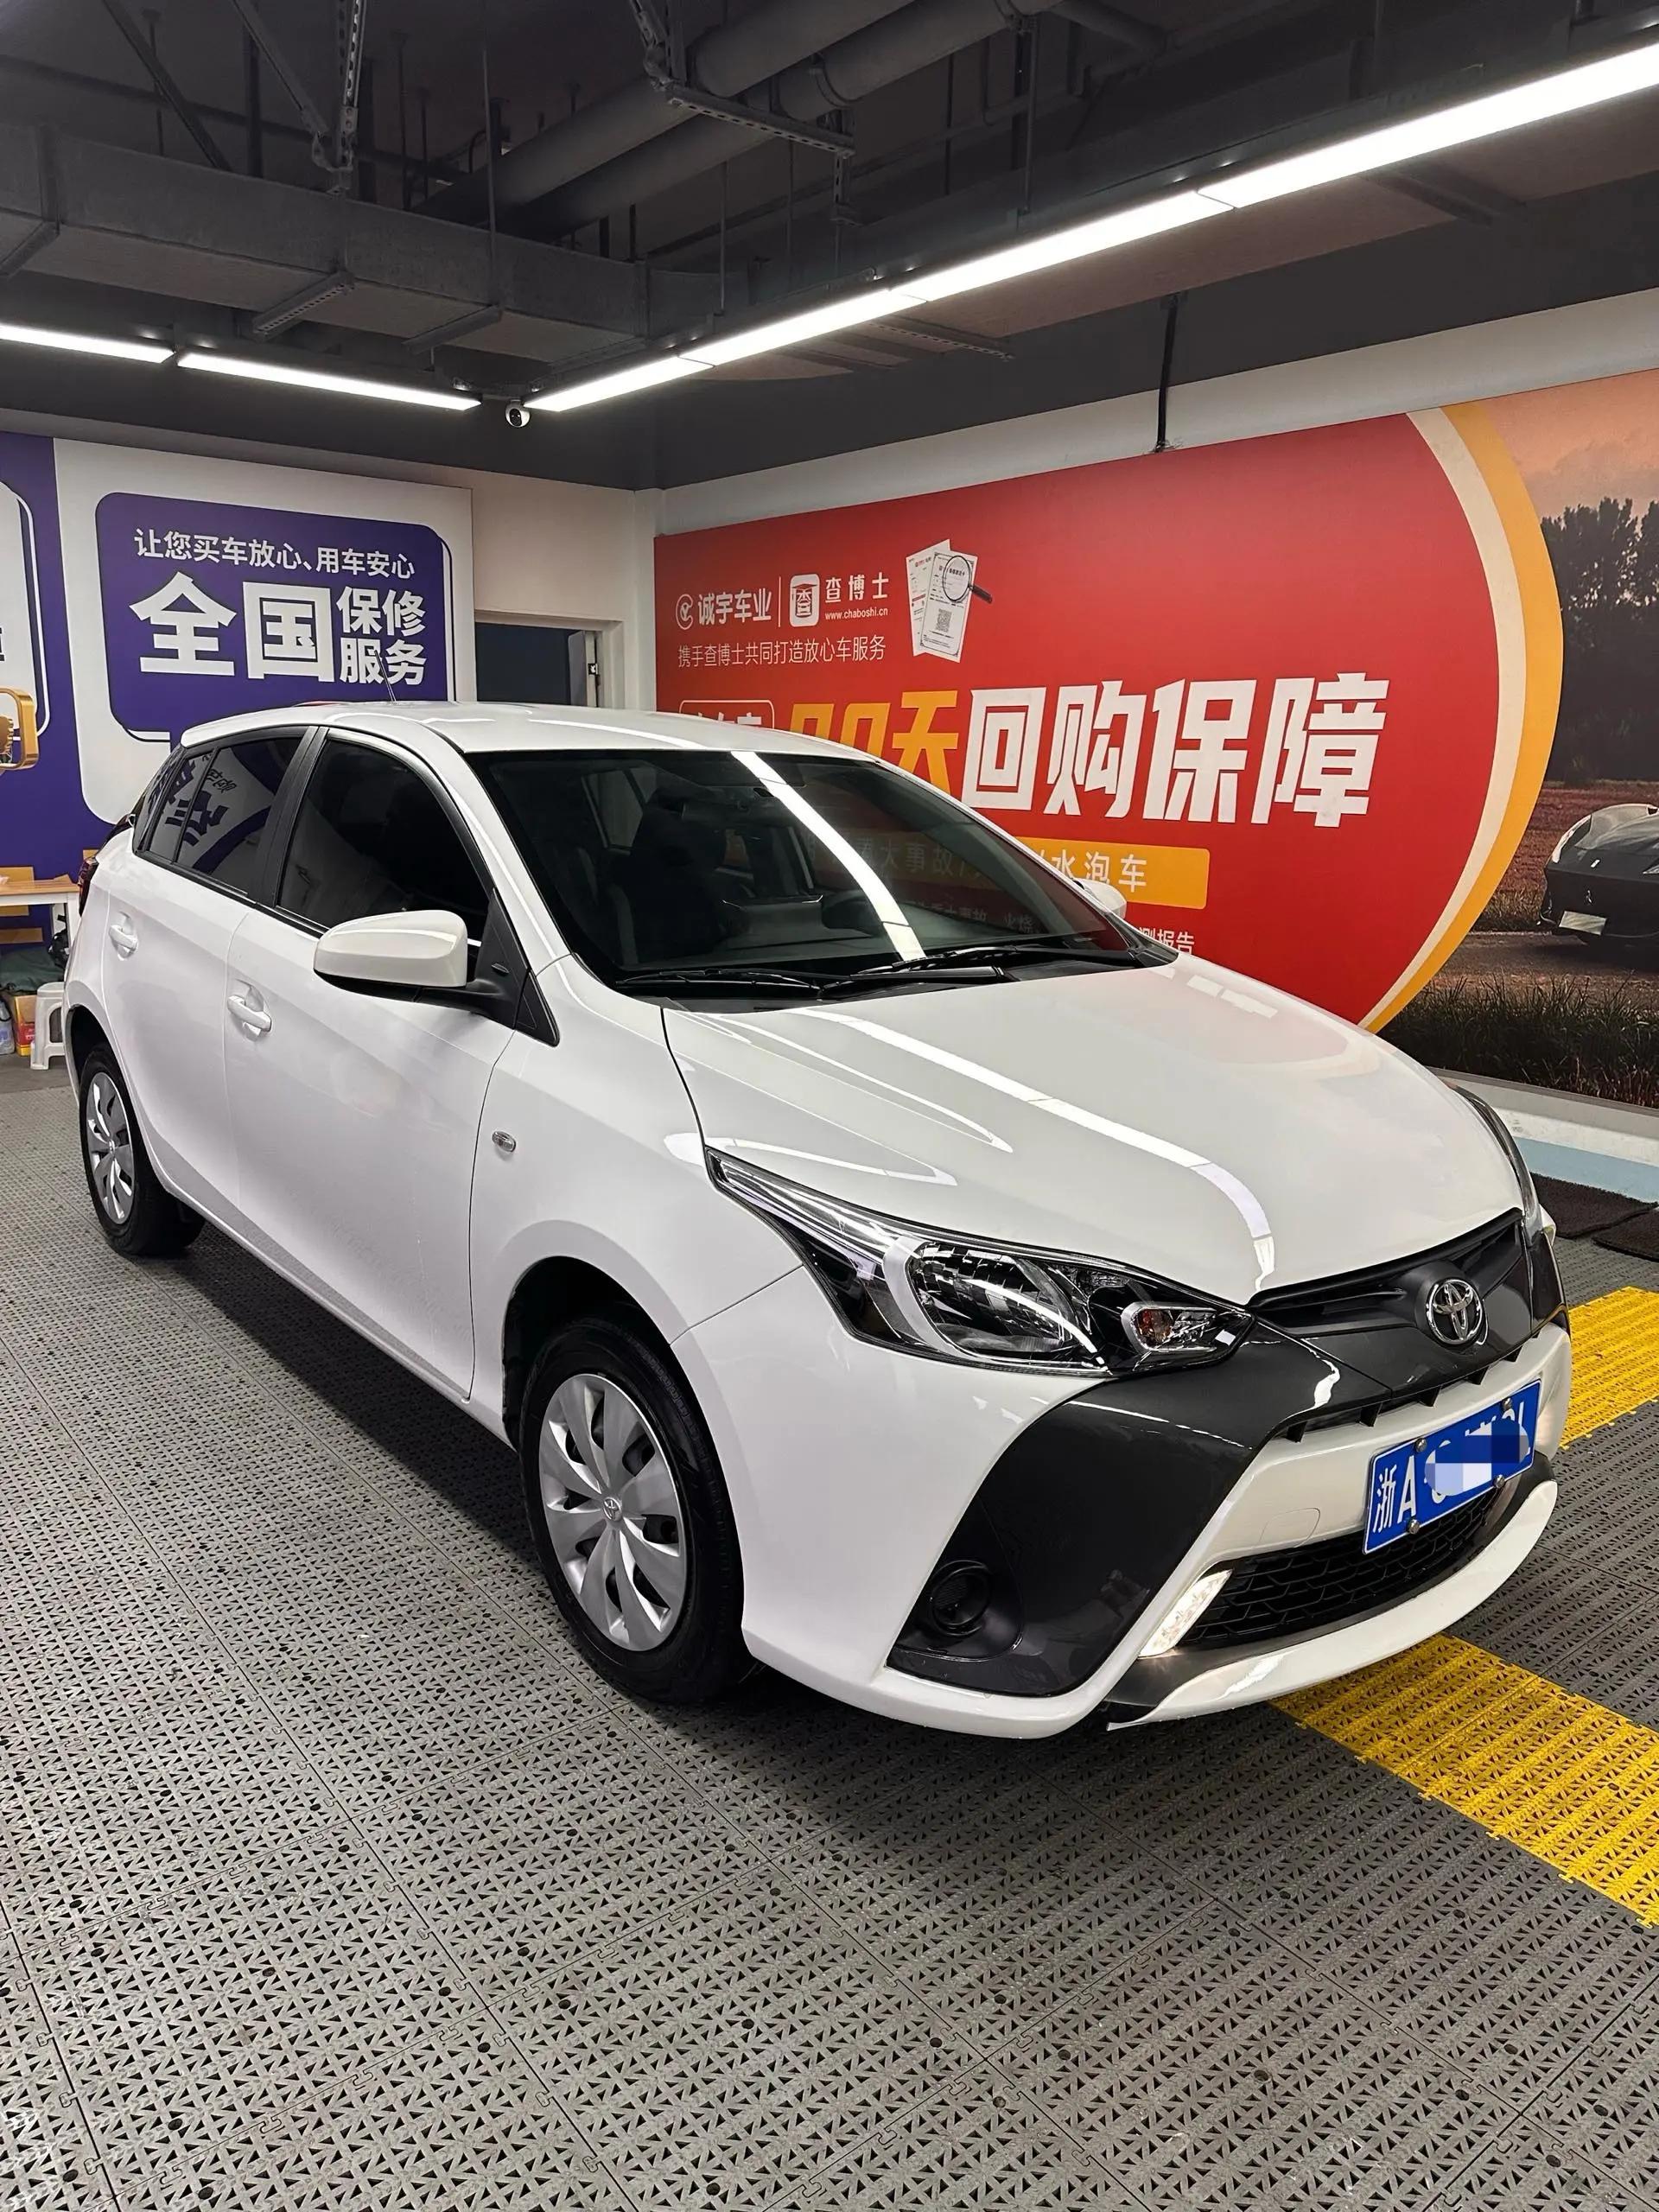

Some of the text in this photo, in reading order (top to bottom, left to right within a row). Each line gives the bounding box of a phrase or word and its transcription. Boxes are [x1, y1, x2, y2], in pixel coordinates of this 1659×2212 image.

[134, 528, 415, 580] 让您买车放心、用车安心
[698, 588, 772, 626] 诚宇车业
[824, 572, 889, 603] 查博士
[129, 571, 335, 683] 全国
[336, 586, 426, 637] 保修
[824, 607, 888, 620] www.chaboshi.cn
[340, 637, 427, 685] 服务
[678, 634, 887, 668] 携手查博士共同打造放心车服务
